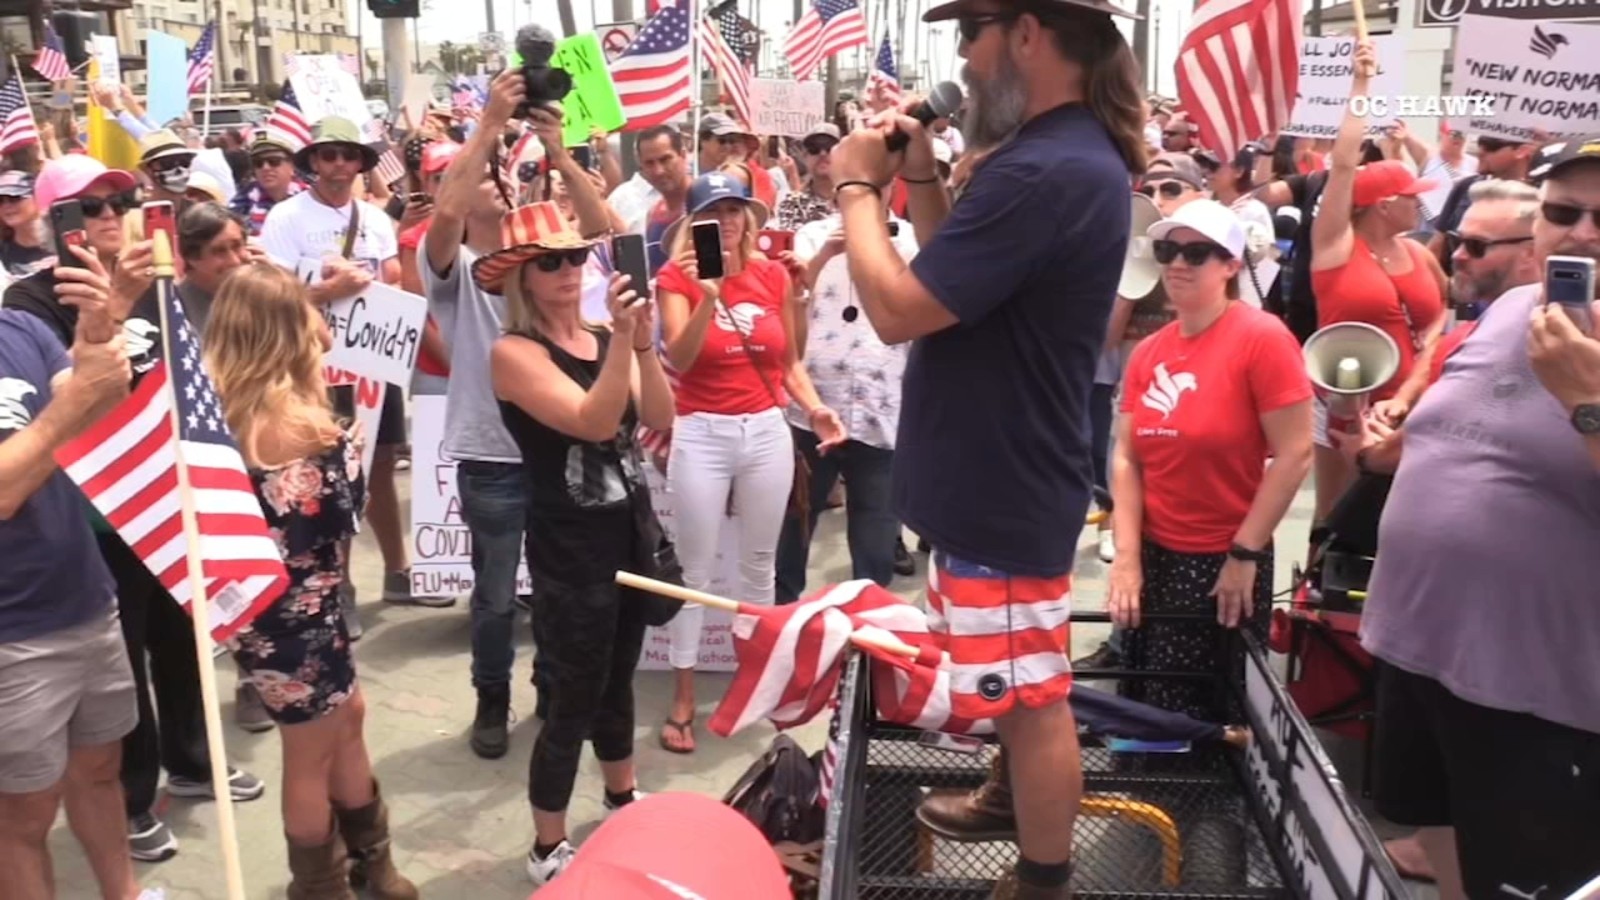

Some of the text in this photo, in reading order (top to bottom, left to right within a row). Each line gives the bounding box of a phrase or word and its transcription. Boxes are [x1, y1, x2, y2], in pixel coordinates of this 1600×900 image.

[1523, 69, 1600, 93] NORMA
[1520, 97, 1600, 120] NORMA
[415, 525, 473, 559] COVI
